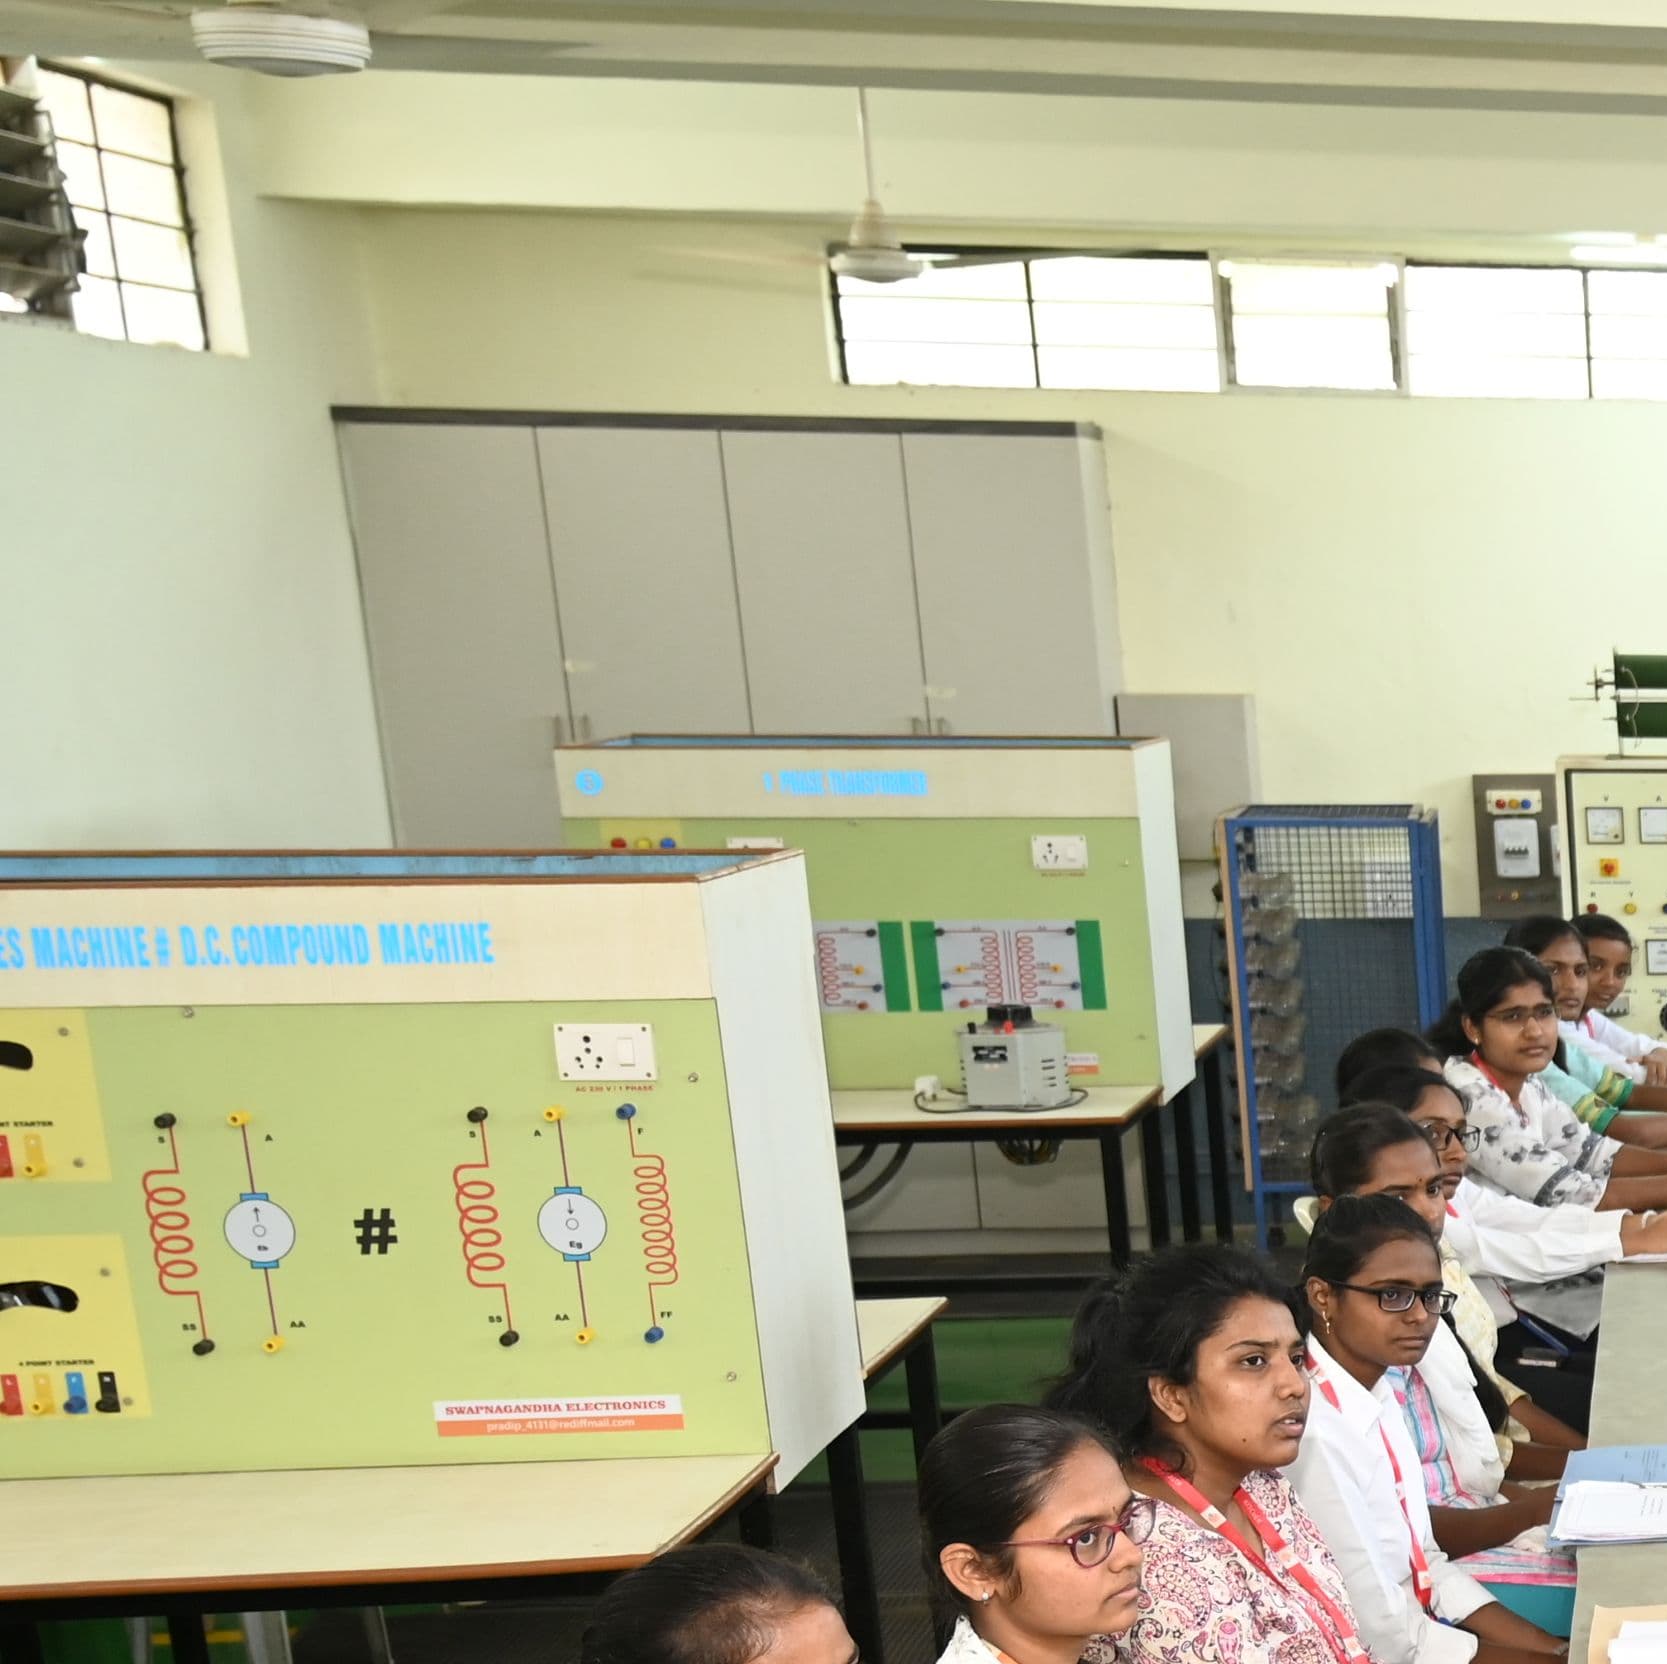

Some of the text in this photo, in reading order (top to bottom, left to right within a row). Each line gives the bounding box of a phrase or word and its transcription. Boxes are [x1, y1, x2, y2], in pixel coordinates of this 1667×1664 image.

[31, 926, 151, 968] MACHINE
[377, 922, 495, 964] MACHINE
[265, 1134, 273, 1142] A
[569, 1241, 583, 1249] Eg
[555, 1313, 570, 1321] AA
[289, 1321, 306, 1329] AA
[445, 1400, 667, 1416] SWAPNAGANDHA ELECTRONICS
